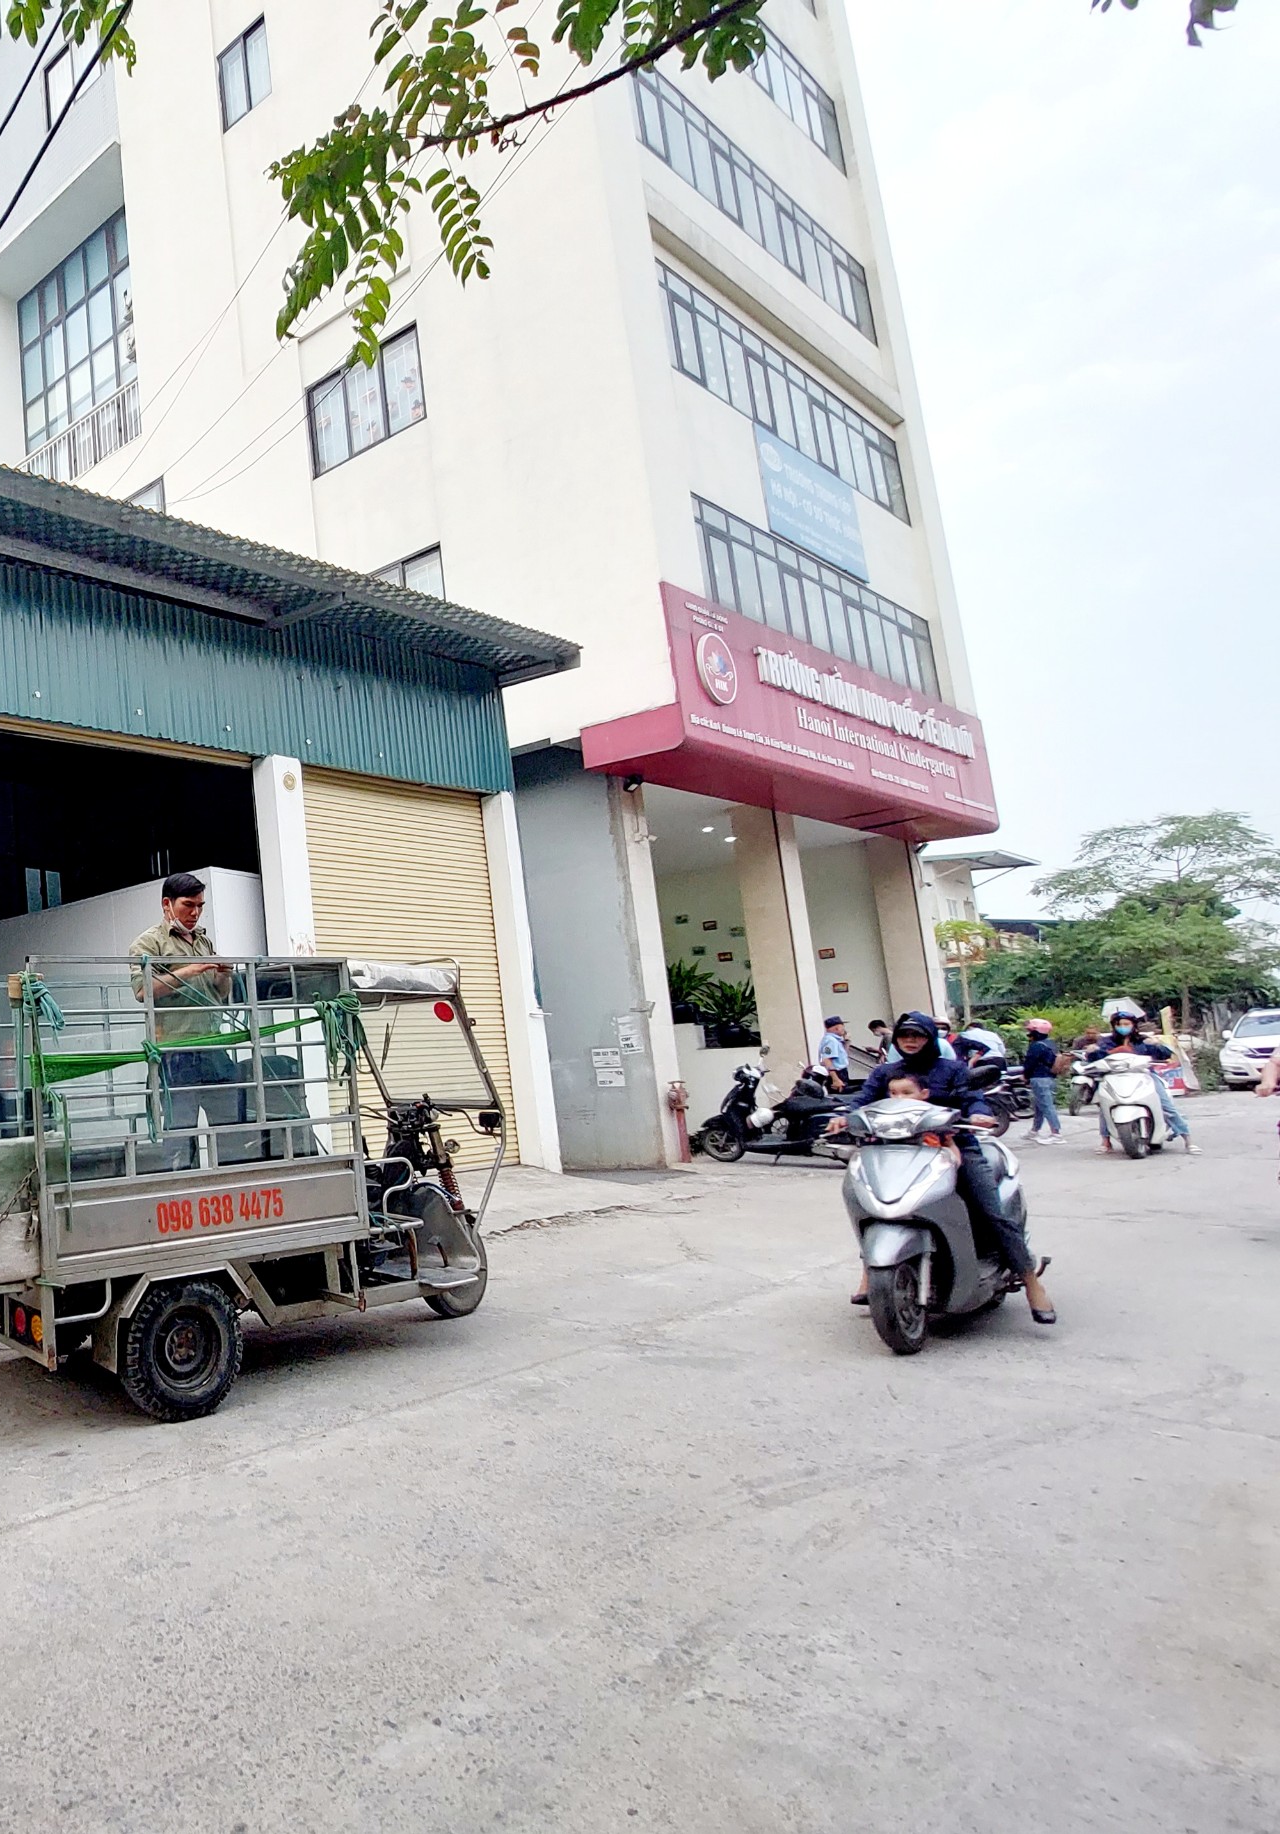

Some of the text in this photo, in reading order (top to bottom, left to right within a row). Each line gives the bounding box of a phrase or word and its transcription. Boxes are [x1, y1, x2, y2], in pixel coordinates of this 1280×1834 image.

[754, 646, 823, 702] TRƯỜNG
[820, 666, 862, 717] MẦM
[858, 687, 892, 728] NON
[797, 707, 833, 738] Hanoi
[831, 718, 900, 760] International
[898, 742, 956, 779] Kindergarten
[155, 1188, 283, 1234] 098 638 4475
